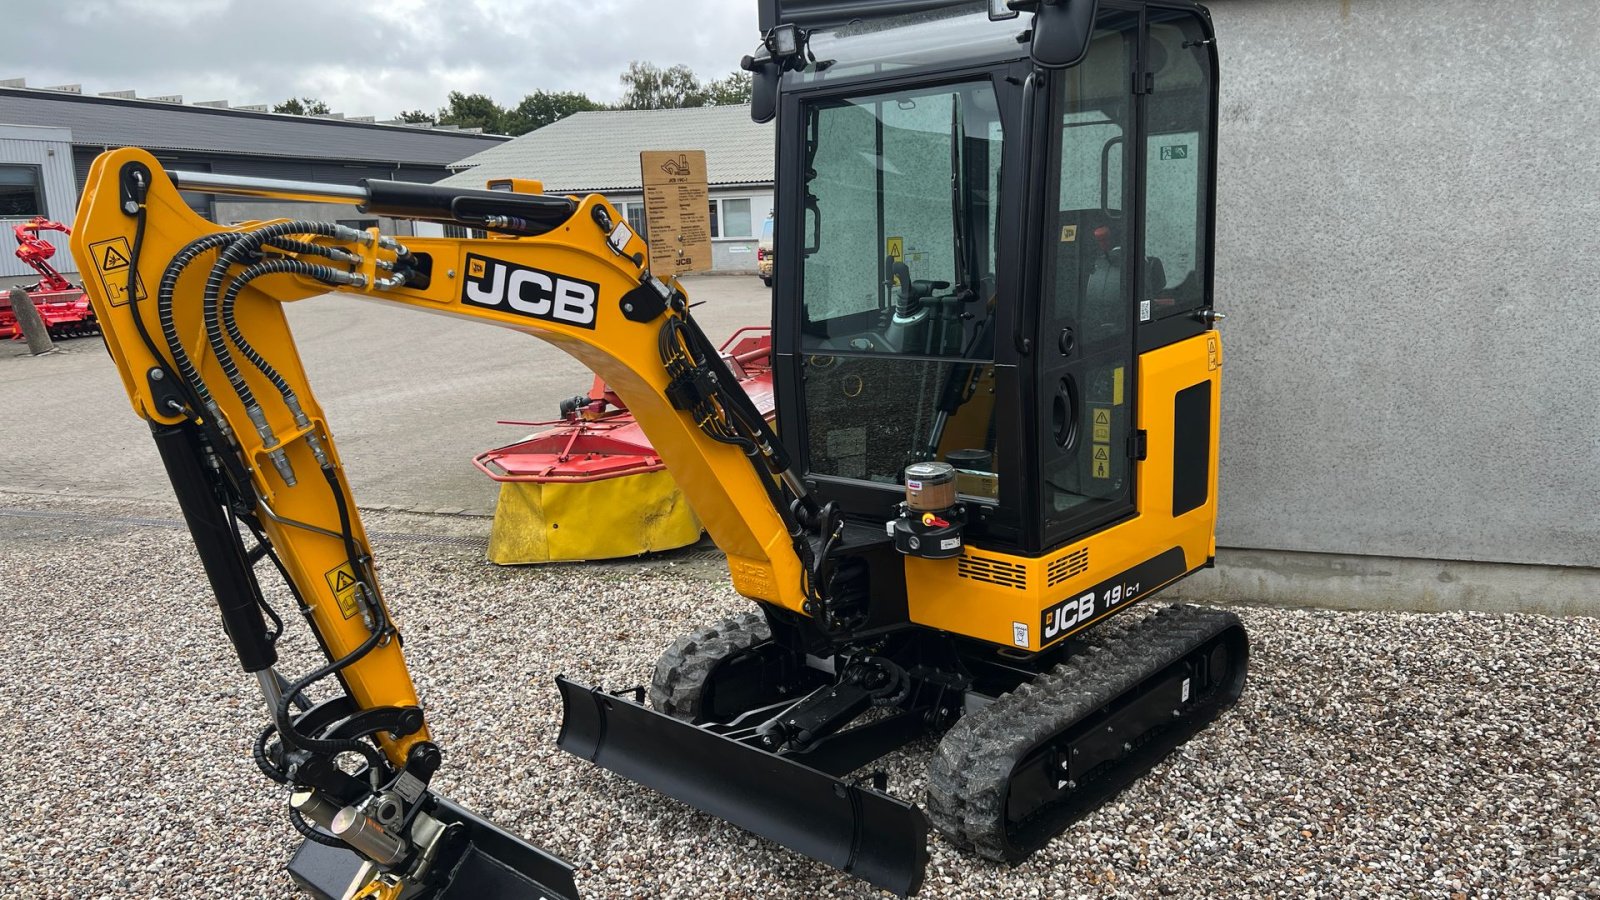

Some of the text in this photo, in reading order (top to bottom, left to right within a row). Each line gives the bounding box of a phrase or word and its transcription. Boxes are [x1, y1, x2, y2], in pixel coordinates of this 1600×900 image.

[676, 258, 691, 266] JCB
[466, 263, 595, 324] JCB
[1045, 592, 1095, 639] JCB
